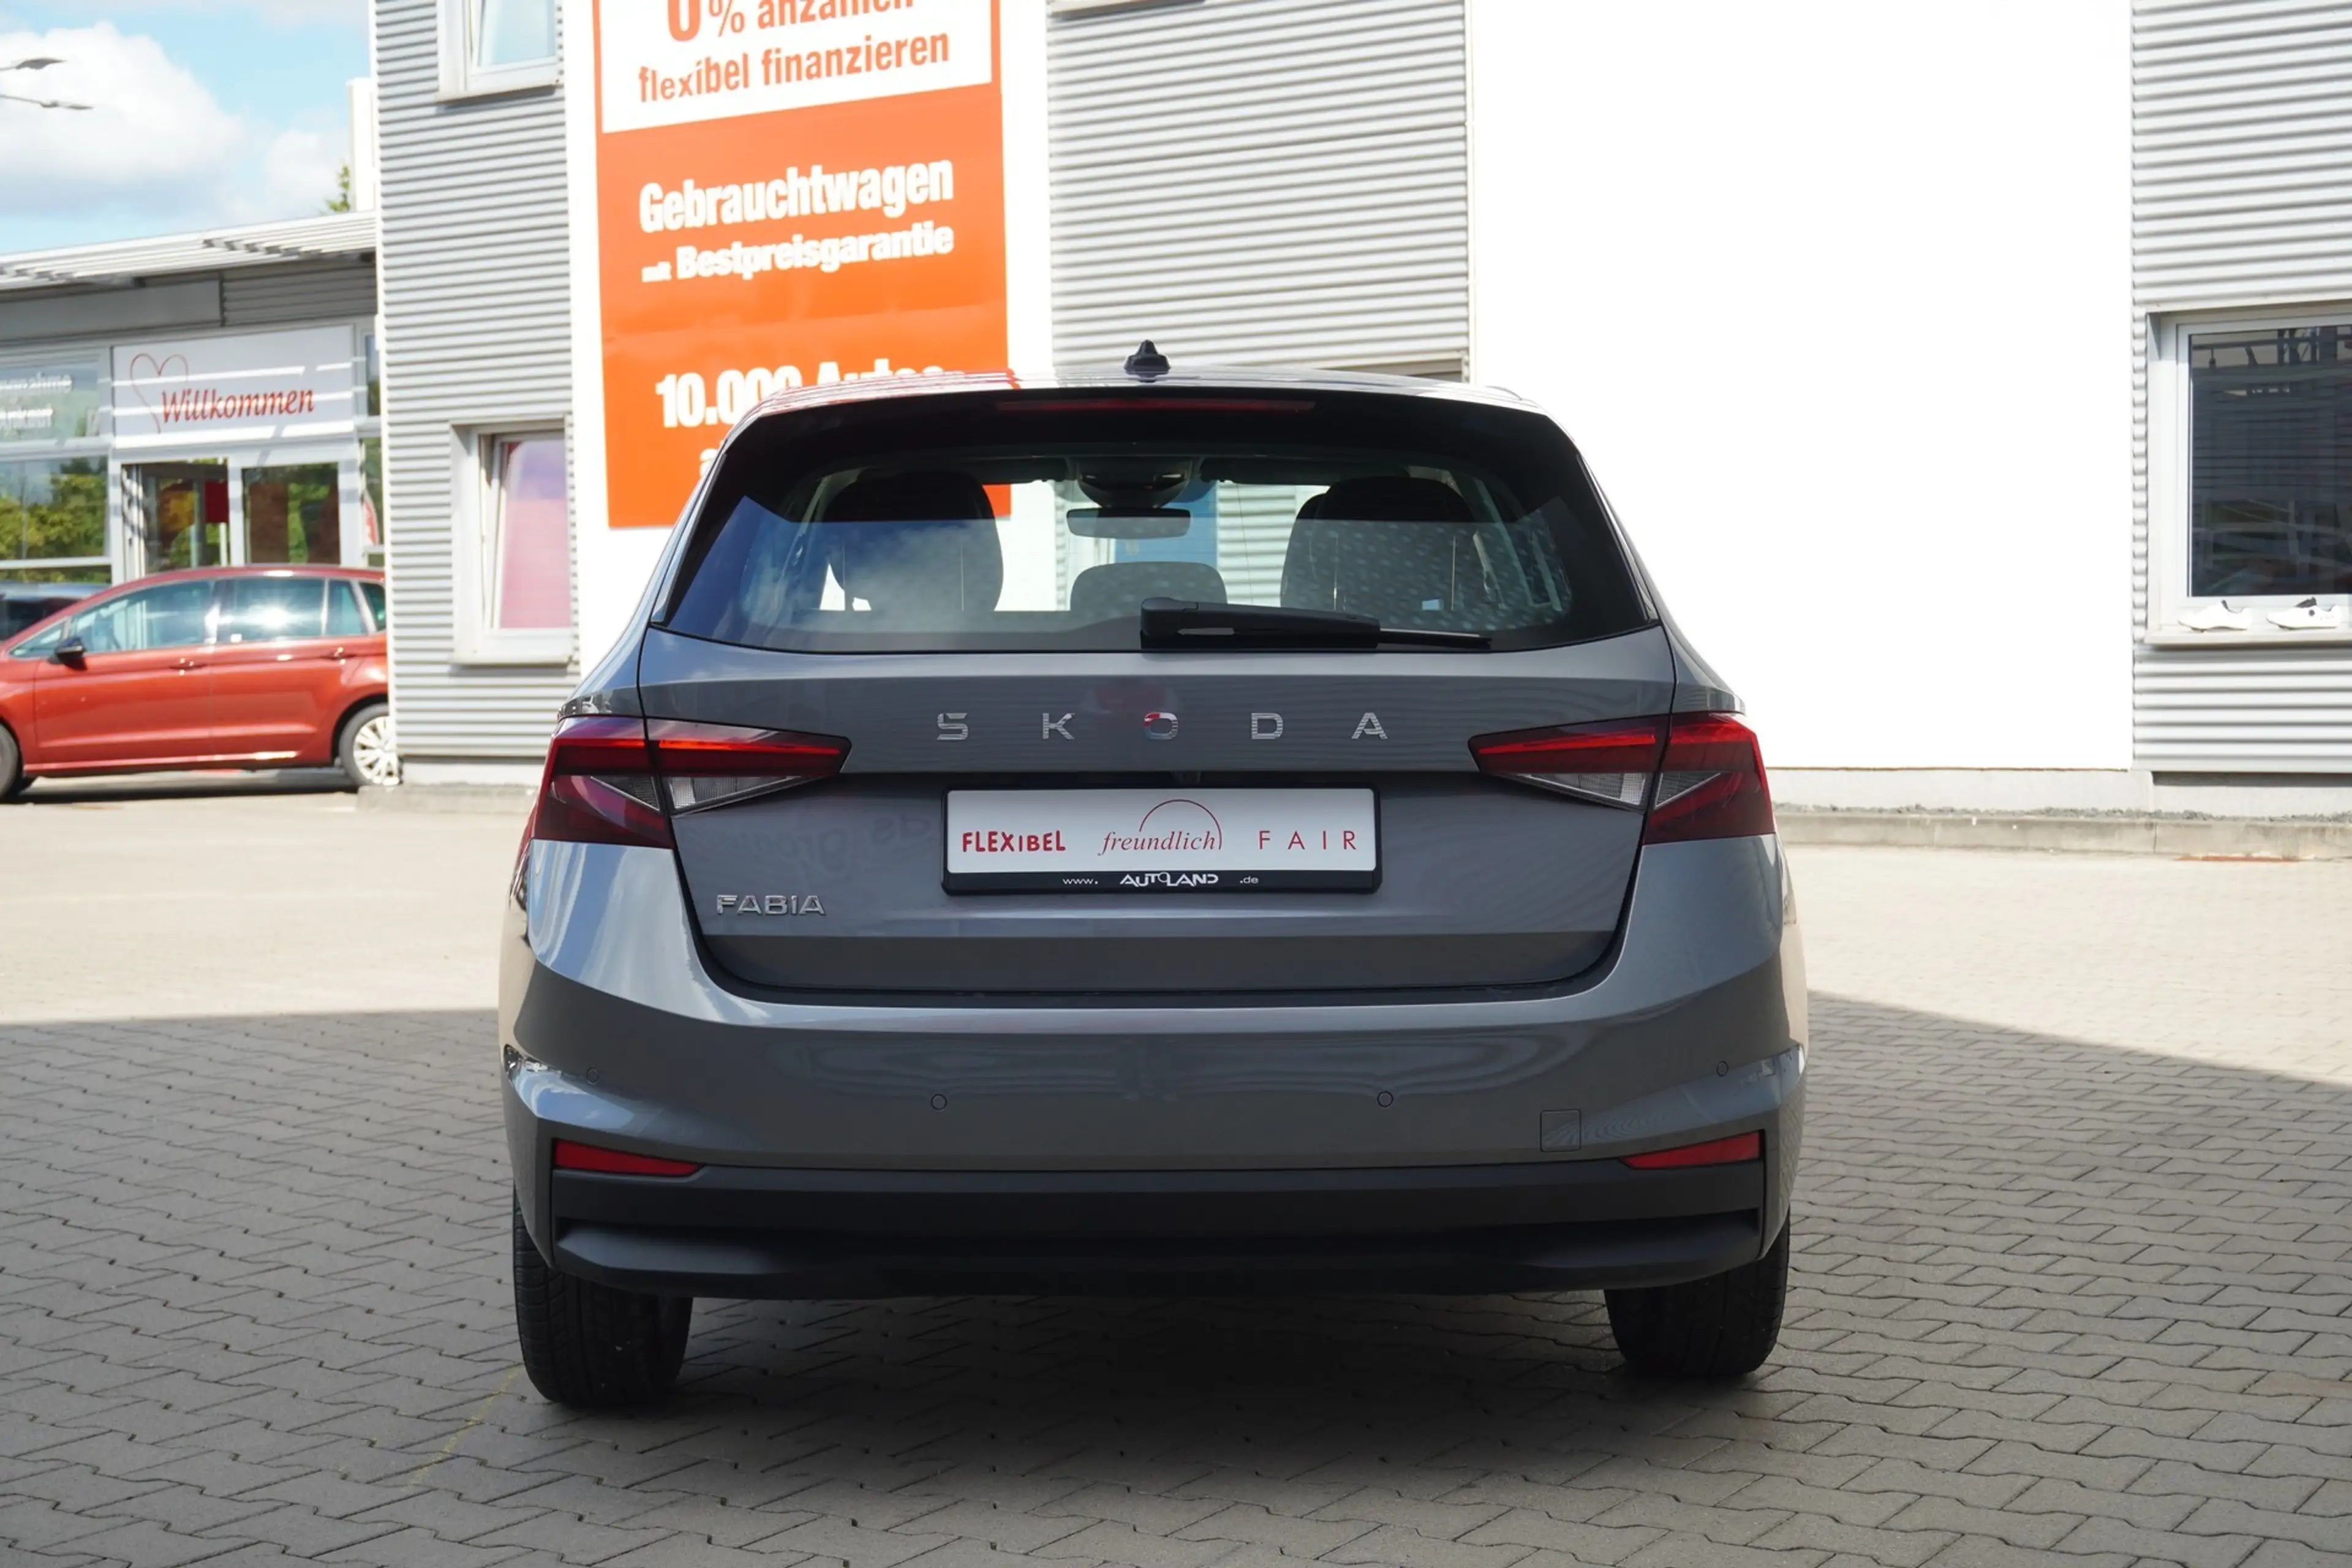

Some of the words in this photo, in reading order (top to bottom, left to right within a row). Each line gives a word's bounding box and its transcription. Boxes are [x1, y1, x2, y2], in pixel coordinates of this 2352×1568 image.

[757, 0, 914, 29] anza
[639, 53, 750, 102] flexibel
[761, 32, 949, 86] finanzieren
[639, 160, 954, 233] Gebrauchtwagen
[676, 221, 954, 280] Bestpreisgarantie
[162, 388, 314, 423] Willkommen
[962, 830, 1066, 853] FLEXIBEL
[1098, 831, 1216, 856] freundlich
[1259, 831, 1356, 850] FAIR
[1120, 872, 1219, 887] AUTOLAND
[1240, 876, 1259, 884] .de
[716, 894, 826, 916] FABIA
